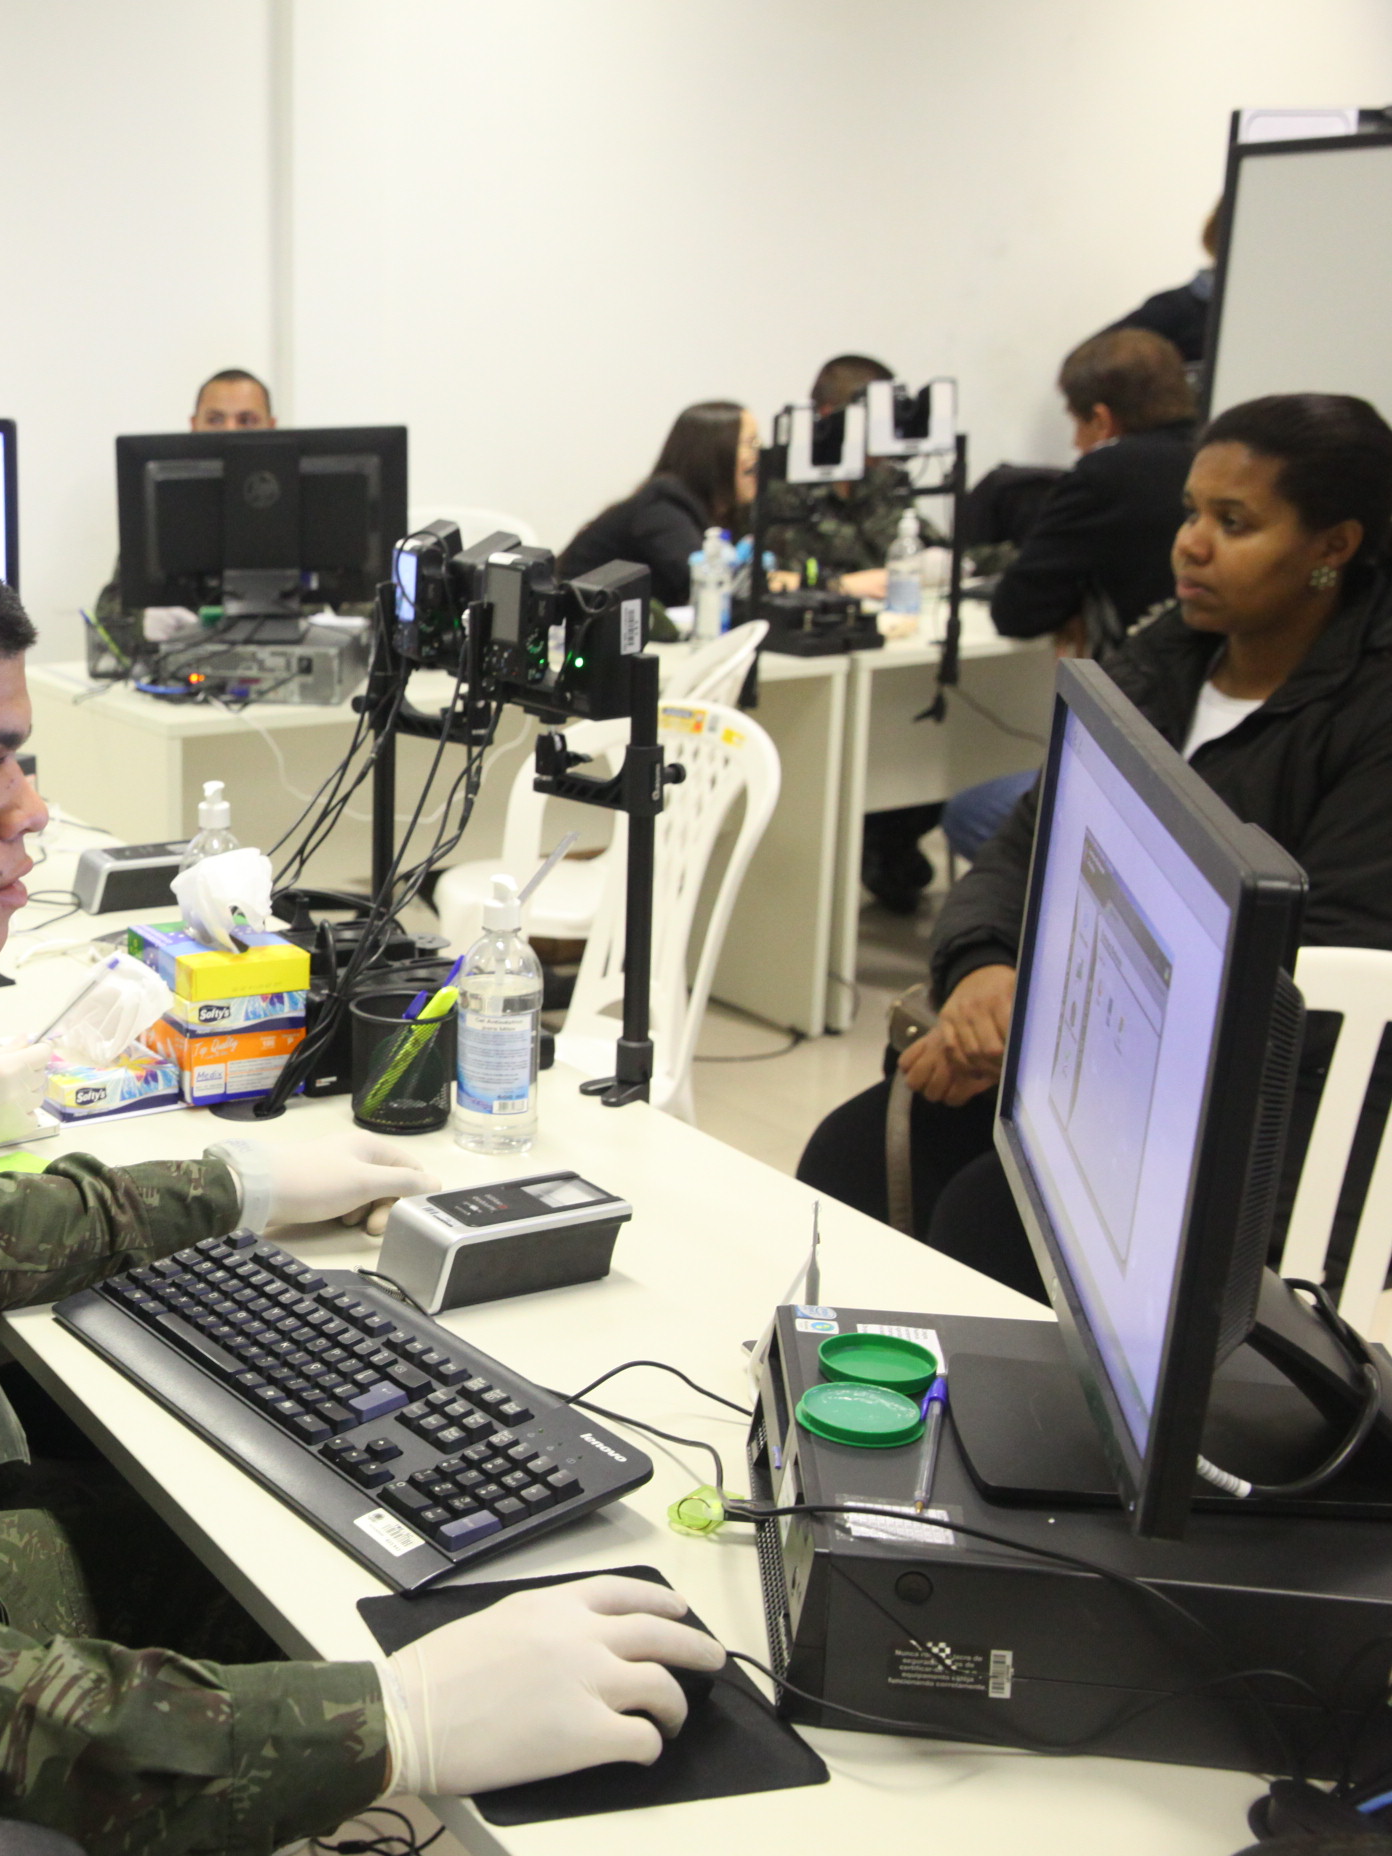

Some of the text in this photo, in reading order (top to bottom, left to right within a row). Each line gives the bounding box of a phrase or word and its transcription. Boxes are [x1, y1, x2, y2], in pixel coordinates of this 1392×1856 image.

[199, 1006, 230, 1021] Softy's
[196, 1071, 223, 1081] Medix
[76, 1089, 106, 1103] Softy's
[580, 1432, 627, 1463] lenovo
